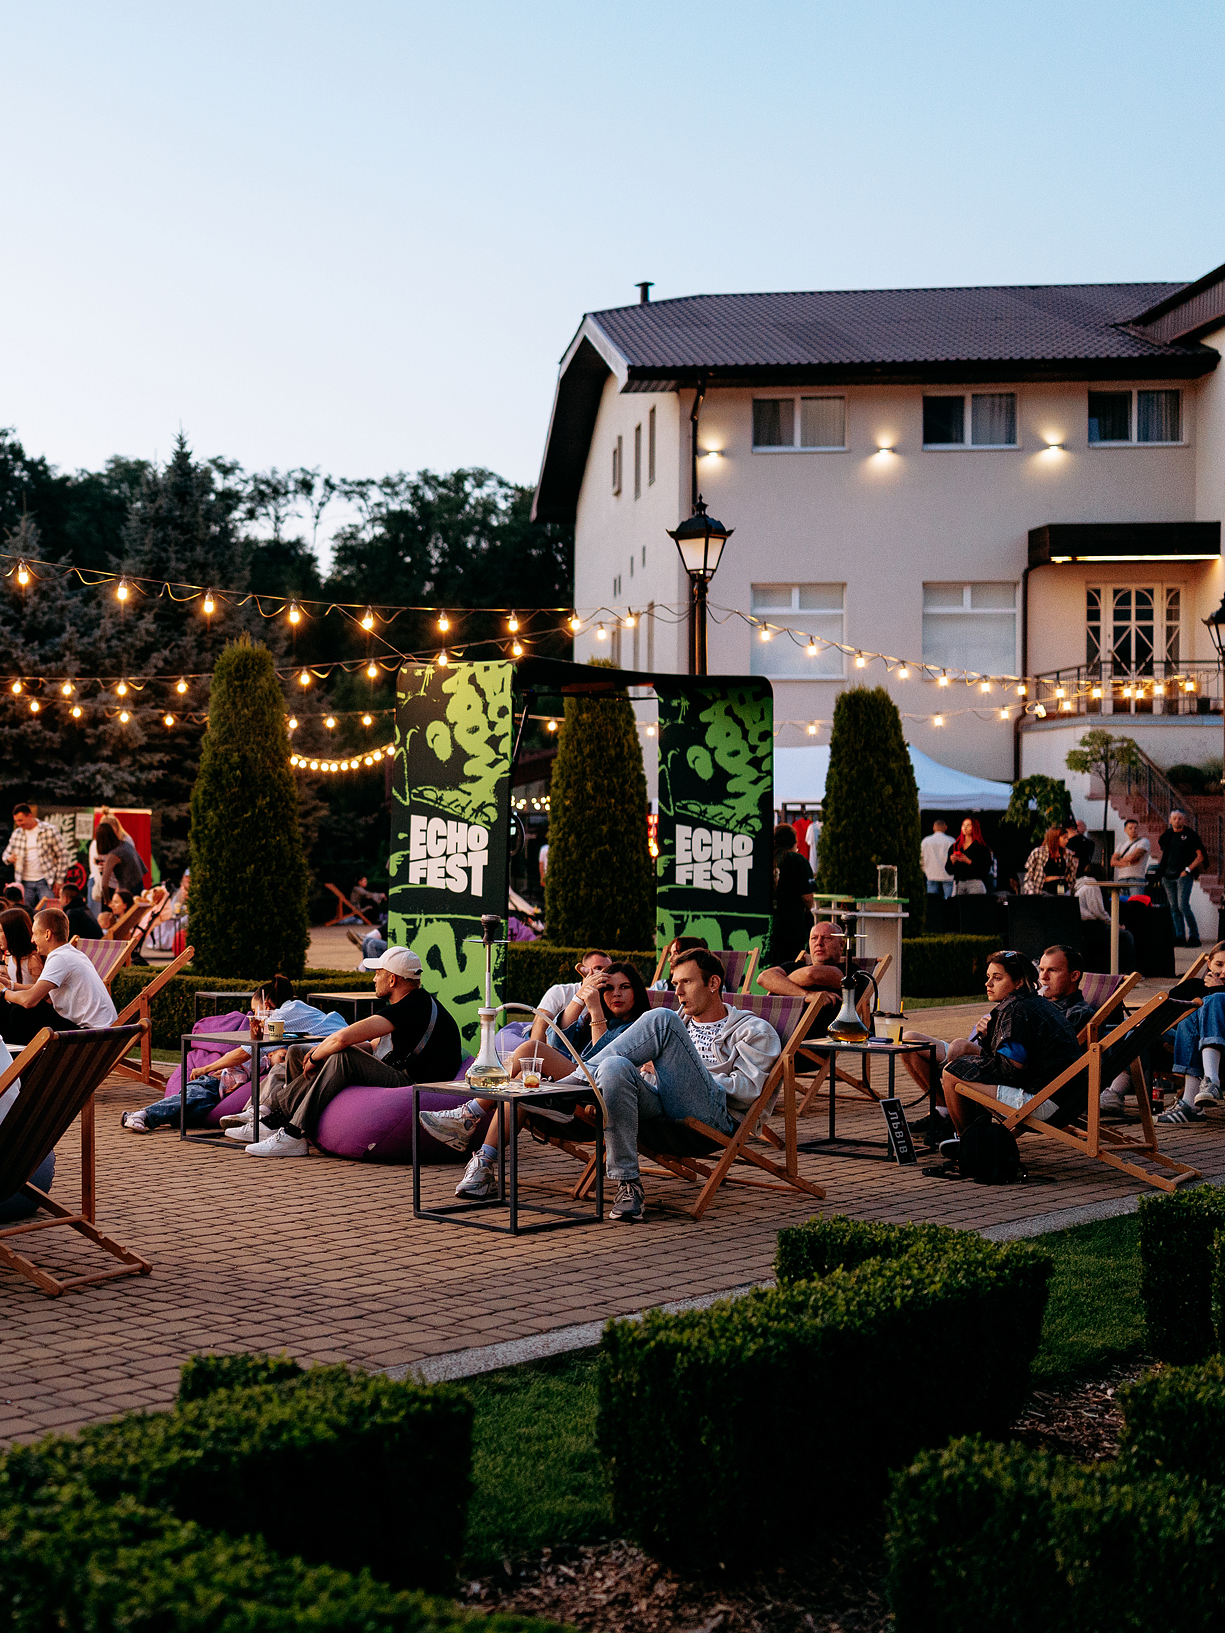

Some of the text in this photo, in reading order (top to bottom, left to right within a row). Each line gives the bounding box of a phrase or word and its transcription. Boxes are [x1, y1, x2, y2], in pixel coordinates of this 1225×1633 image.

[410, 815, 488, 861] ECHO
[676, 824, 753, 864] ECHO
[409, 850, 488, 897] FEST
[676, 855, 753, 896] FEST
